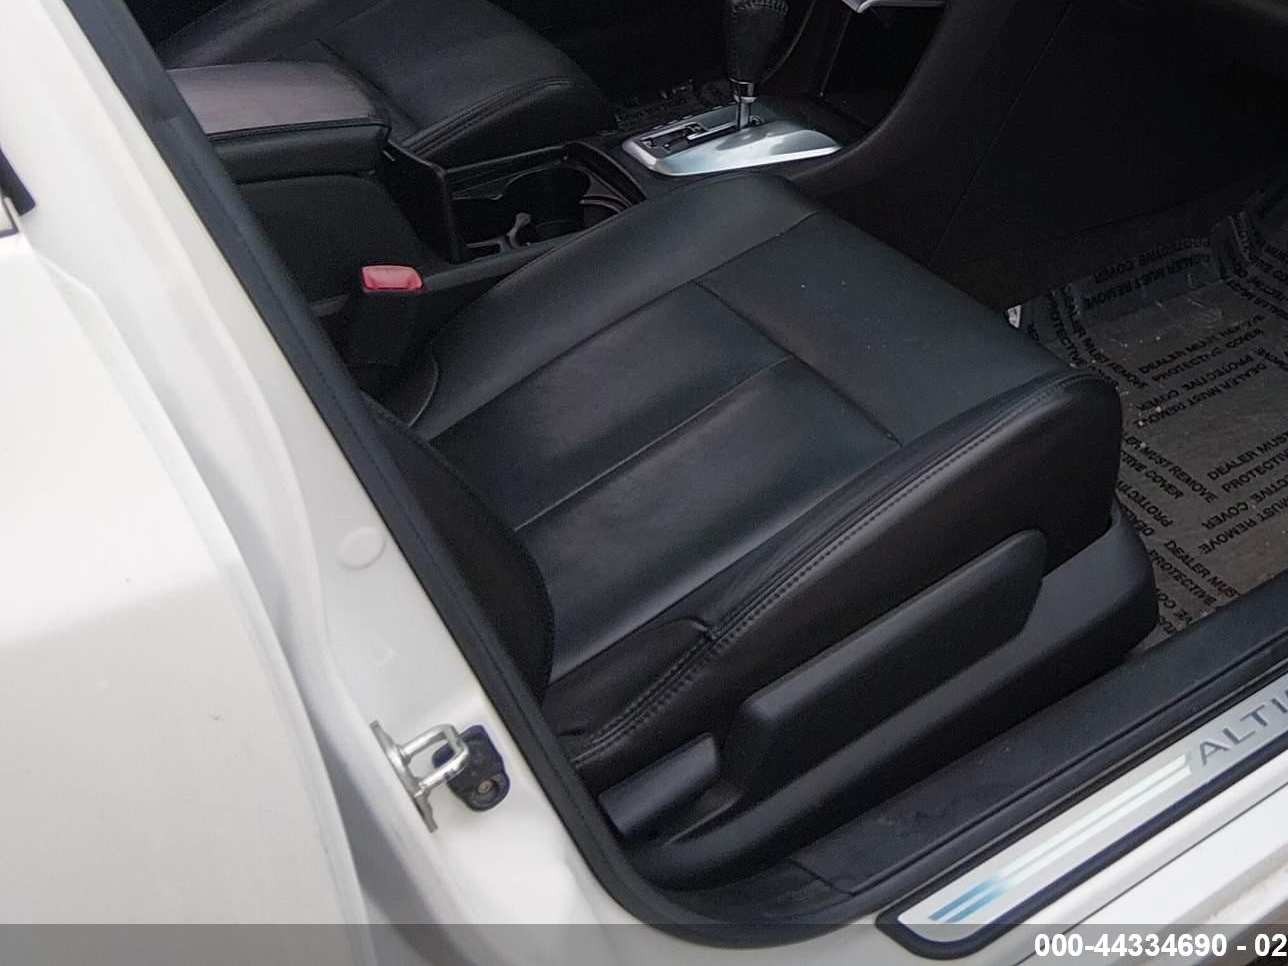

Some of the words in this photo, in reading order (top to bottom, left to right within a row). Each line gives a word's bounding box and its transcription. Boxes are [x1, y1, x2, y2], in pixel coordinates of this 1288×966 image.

[1138, 346, 1186, 375] DEALER
[1181, 354, 1254, 391] PROTECTIVE
[1139, 445, 1172, 468] MUST
[1168, 464, 1219, 504] REMOVE
[1206, 448, 1260, 481] DEALER
[1144, 469, 1185, 500] COVER
[1197, 514, 1258, 555] REMOVE
[1201, 501, 1249, 531] COVER
[1163, 539, 1212, 579] DEALER
[1148, 549, 1218, 607] PROTECTIVE
